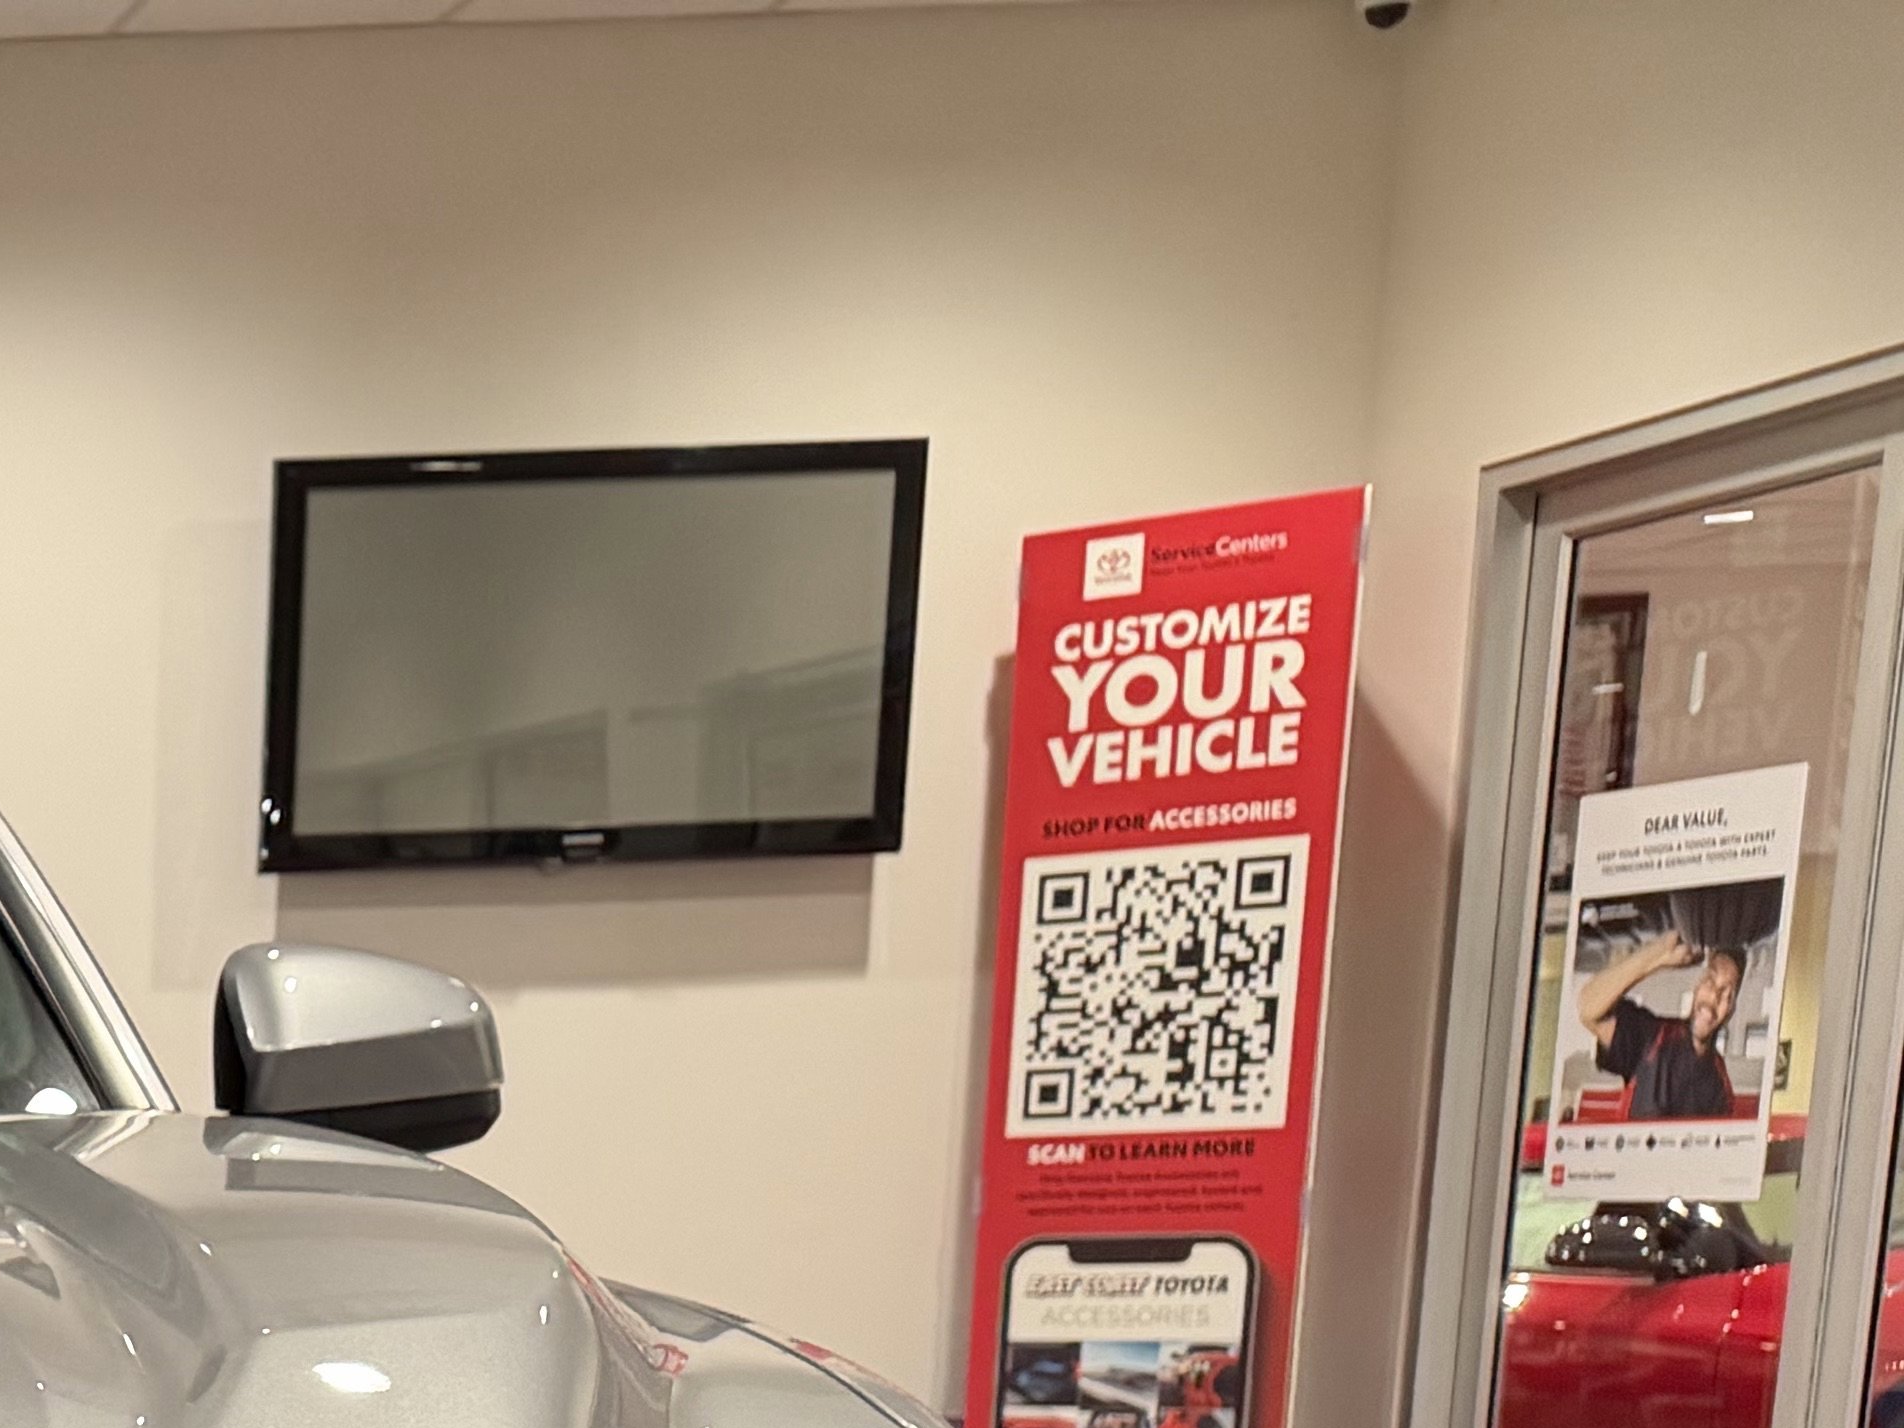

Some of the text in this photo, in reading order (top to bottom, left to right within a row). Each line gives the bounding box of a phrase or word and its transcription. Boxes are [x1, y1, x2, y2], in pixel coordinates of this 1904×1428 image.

[1054, 593, 1312, 663] CUSTOMIZE
[1050, 639, 1307, 733] YOUR
[1047, 712, 1301, 788] VEHICLE
[1043, 797, 1297, 839] SHOP FOR ACCESSORIES
[1644, 807, 1728, 835] DEAR VALUE,
[1027, 1138, 1255, 1166] SCAN TO LEARN MORE
[1154, 1274, 1229, 1297] TOYOTA
